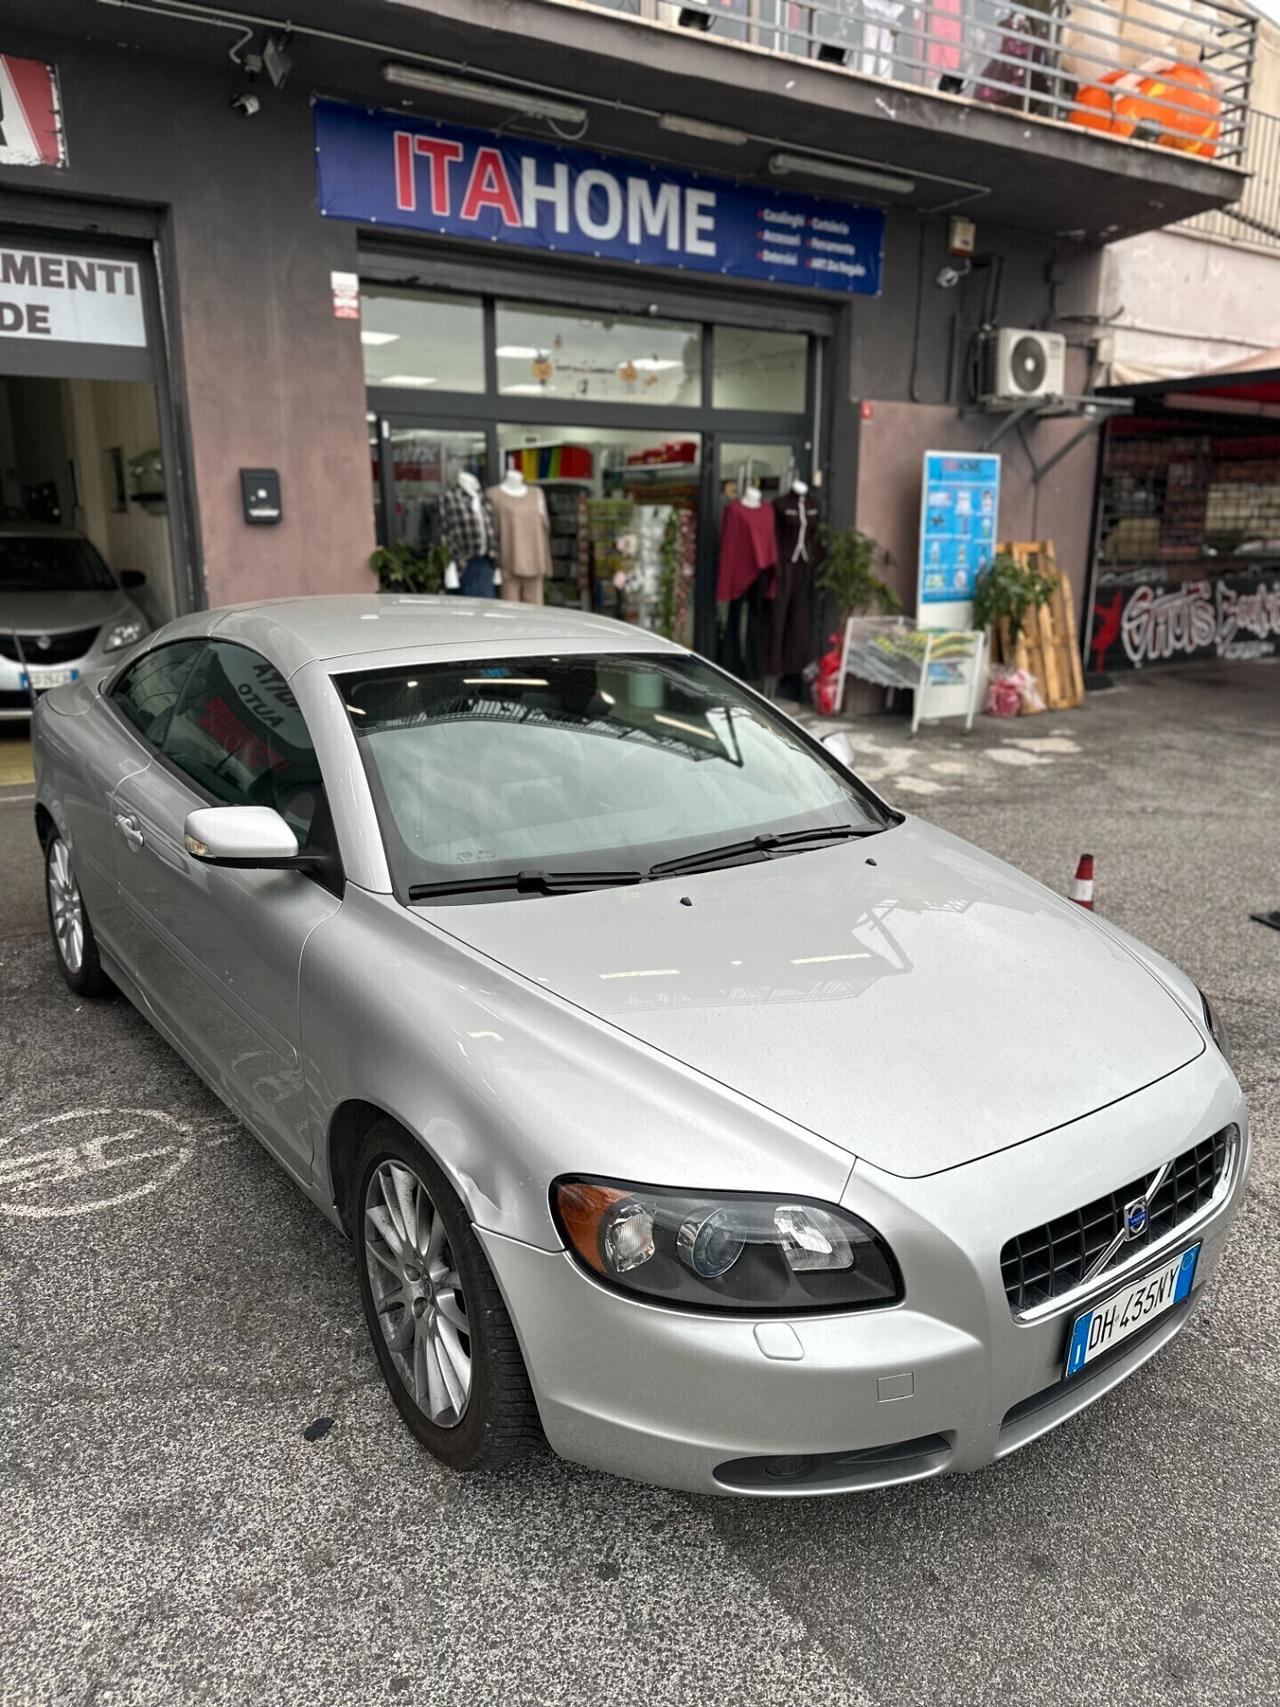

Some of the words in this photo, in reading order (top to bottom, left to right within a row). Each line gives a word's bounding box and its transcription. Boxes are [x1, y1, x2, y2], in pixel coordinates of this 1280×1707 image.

[393, 130, 717, 258] ITAHOME
[0, 253, 135, 296] MENTI
[0, 302, 51, 335] DE
